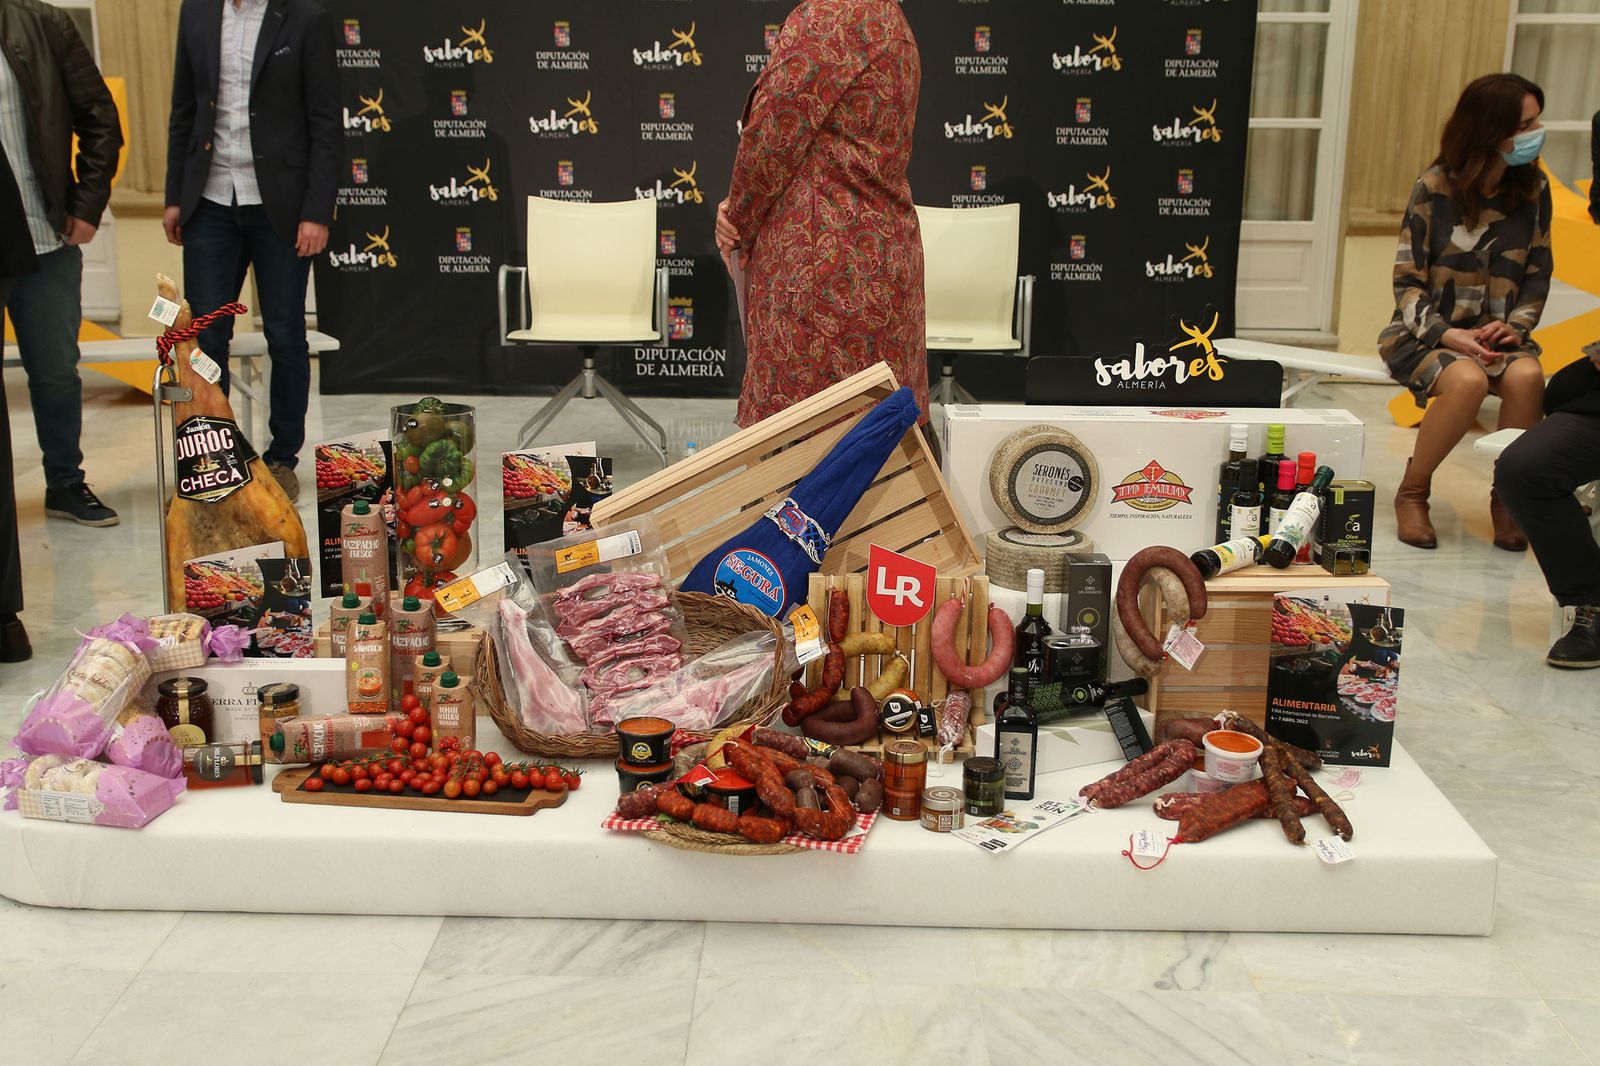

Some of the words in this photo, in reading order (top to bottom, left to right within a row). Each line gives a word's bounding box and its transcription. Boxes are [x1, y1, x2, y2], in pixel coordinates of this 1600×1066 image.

[336, 48, 381, 59] PUTACIÓN
[535, 51, 590, 61] DIPUTACIÓN
[342, 58, 381, 68] ALMERÍA
[745, 54, 771, 64] DIPUT
[954, 56, 1008, 66] DIPUTACIÓN
[1165, 59, 1219, 69] DIPUTACIÓN
[536, 61, 551, 70] DE
[552, 60, 589, 70] ALMERÍA
[955, 66, 968, 74] DE
[968, 65, 1007, 74] ALMERÍA
[1165, 69, 1179, 77] DE
[1180, 69, 1217, 77] ALMERÍA
[433, 119, 487, 129] DIPUTACIÓN
[640, 122, 694, 132] DIPUTACIÓN
[434, 129, 449, 138] DE
[450, 128, 486, 138] ALMERÍA
[641, 131, 656, 140] DE
[657, 131, 693, 141] ALMERÍA
[1056, 126, 1110, 136] DIPUTACIÓN
[1057, 136, 1070, 145] DE
[1070, 136, 1108, 146] ALMERÍA
[350, 196, 387, 205] ALMERÍA
[951, 194, 1004, 204] DIPUTACIÓN
[1158, 197, 1211, 207] DIPUTACIÓN
[1158, 207, 1171, 215] DE
[1172, 207, 1210, 216] ALMERÍA
[438, 255, 491, 265] DIPUTACIÓN
[655, 259, 695, 268] UTACIÓN
[439, 264, 453, 273] DE
[454, 264, 490, 273] ALMERÍA
[1050, 263, 1104, 273] DIPUTACIÓN
[1051, 272, 1064, 280] DE
[1064, 272, 1101, 281] ALMERÍA
[633, 346, 727, 362] DIPUTACIÓN
[635, 363, 656, 377] DE
[658, 361, 725, 377] ALMERÍA
[1094, 341, 1228, 387] sabores
[1116, 379, 1167, 390] ALMERÍA
[1032, 463, 1071, 481] SERONÉS
[180, 467, 244, 492] CHECA
[1143, 482, 1186, 498] EMILIO
[747, 553, 774, 577] JAMONES
[724, 553, 780, 603] SEGURA
[876, 566, 924, 608] LR
[212, 698, 243, 706] ERRA
[1272, 697, 1338, 713] ALIMENTARIA
